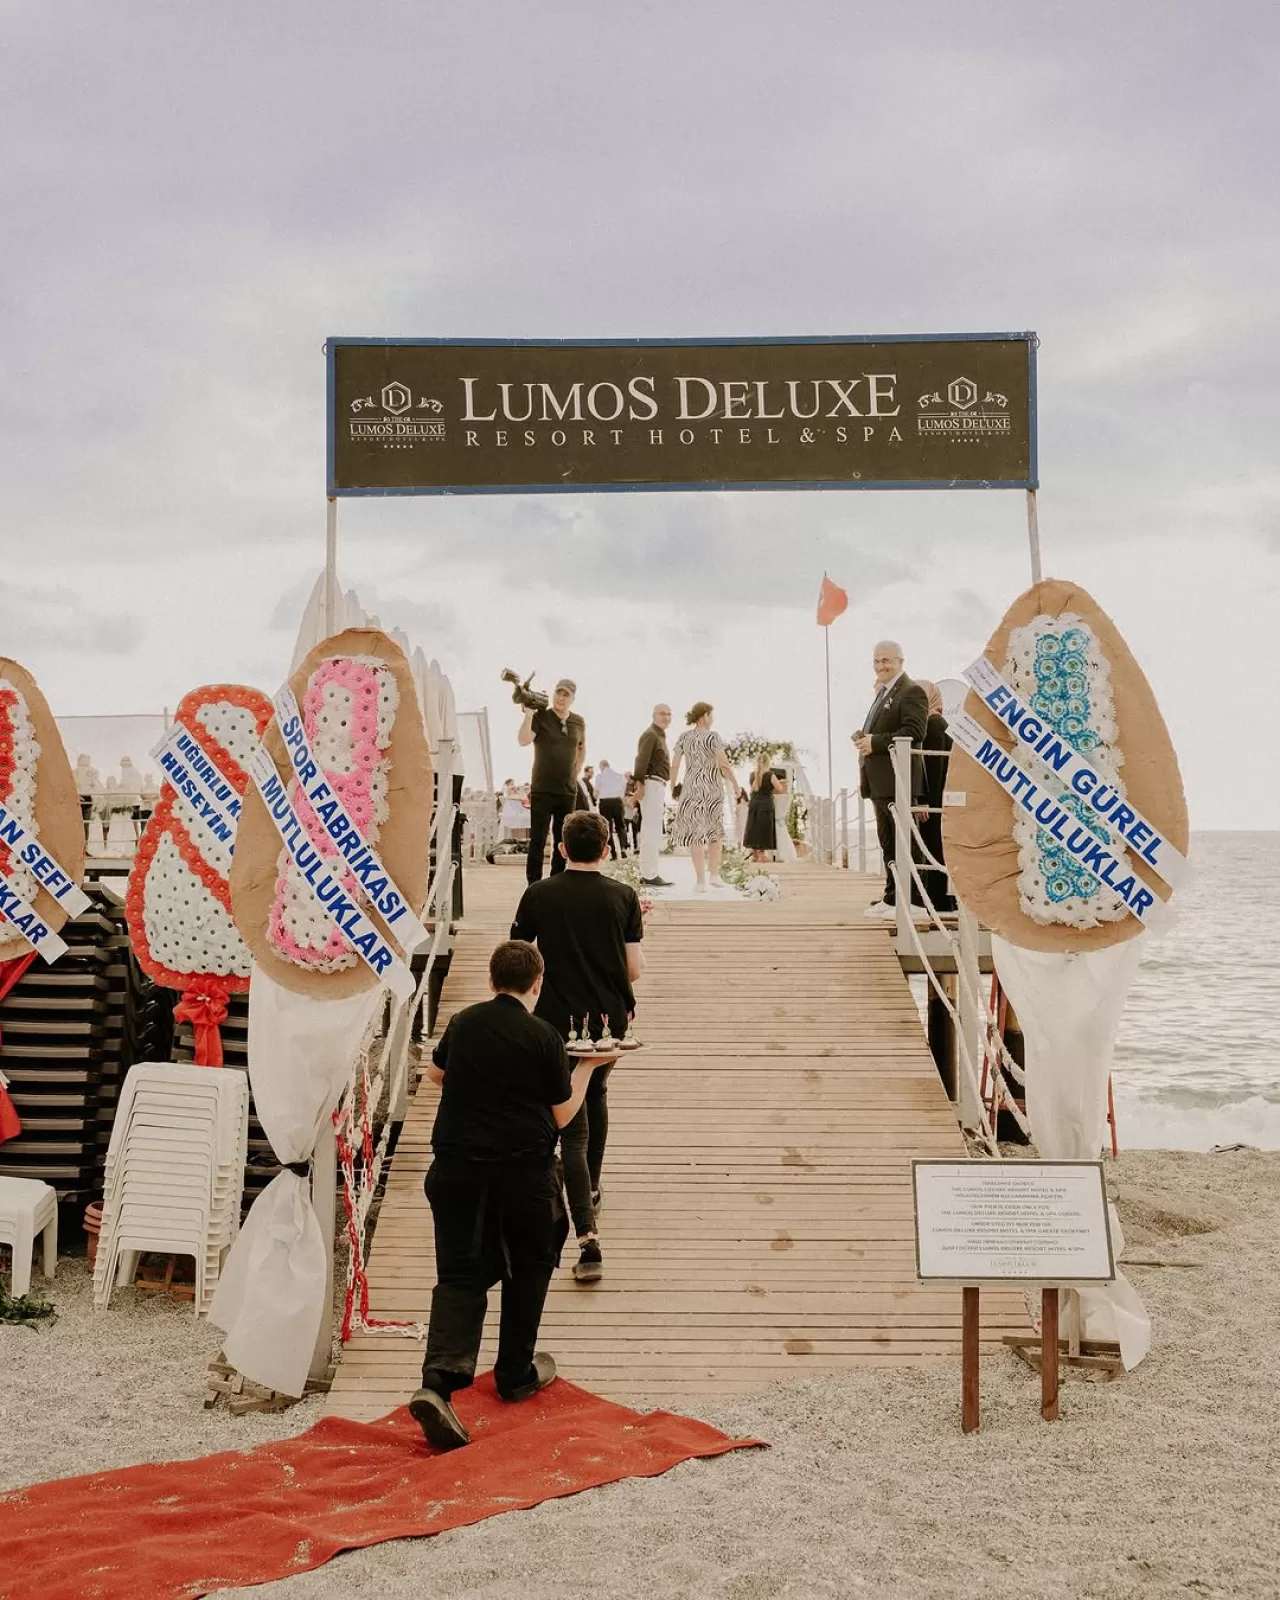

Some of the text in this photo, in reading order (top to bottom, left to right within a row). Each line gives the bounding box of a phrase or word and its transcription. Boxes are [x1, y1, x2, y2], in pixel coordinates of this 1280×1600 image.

[349, 423, 447, 435] LUMOS DELUXE
[458, 373, 901, 422] LUMOS DELUXE
[465, 426, 903, 447] RESORT HOTEL & SPA
[918, 417, 1011, 430] LUMOS DELUXE
[160, 751, 233, 842] HÜSEYİN
[176, 734, 233, 802] UĞURLU
[985, 684, 1164, 866] ENGİN GÜREL
[283, 715, 408, 923] SPOR FABRİKASI
[975, 739, 1154, 917] MUTLULUKLAR
[260, 774, 393, 976] MUTLULUKLAR
